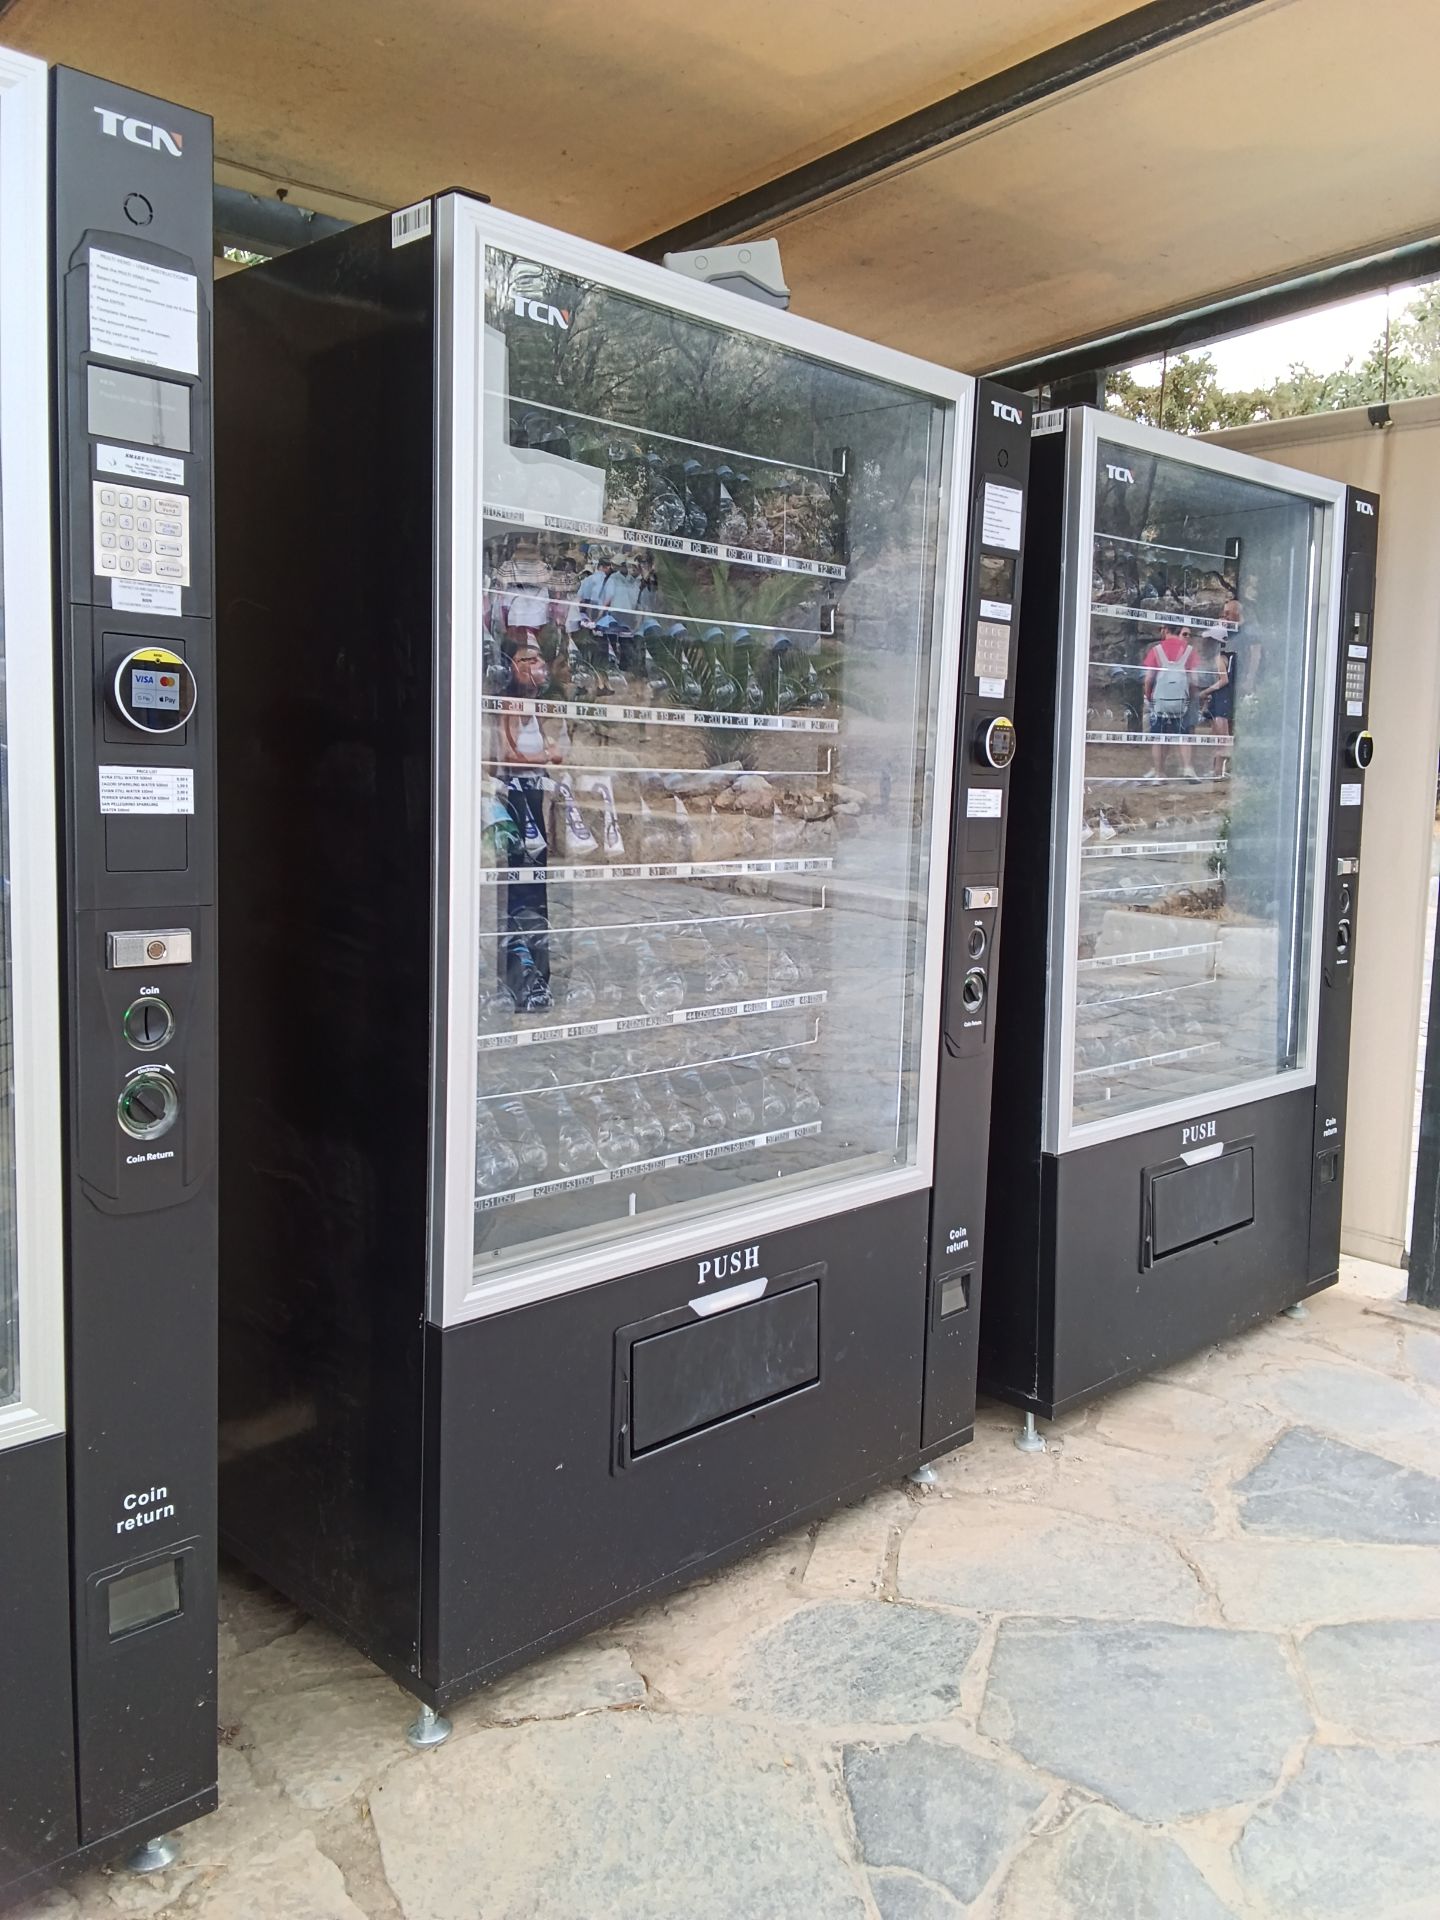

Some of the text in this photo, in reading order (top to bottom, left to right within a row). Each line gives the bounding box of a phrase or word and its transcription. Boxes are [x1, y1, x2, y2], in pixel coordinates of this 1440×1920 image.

[94, 106, 182, 156] TCN
[510, 295, 570, 330] TCN
[991, 400, 1023, 425] TCN
[1105, 464, 1135, 484] TCN
[1355, 500, 1374, 516] TCN
[135, 675, 154, 684] VISA
[165, 696, 176, 704] Pay
[535, 869, 546, 880] 28
[139, 986, 160, 996] Coin
[1325, 1117, 1337, 1127] Coin
[1182, 1120, 1217, 1145] PUSH
[126, 1150, 174, 1164] Coin Return
[949, 1226, 967, 1241] Coin
[946, 1238, 969, 1254] return
[697, 1245, 761, 1284] PUSH
[123, 1486, 168, 1510] Coin
[116, 1504, 175, 1534] return
